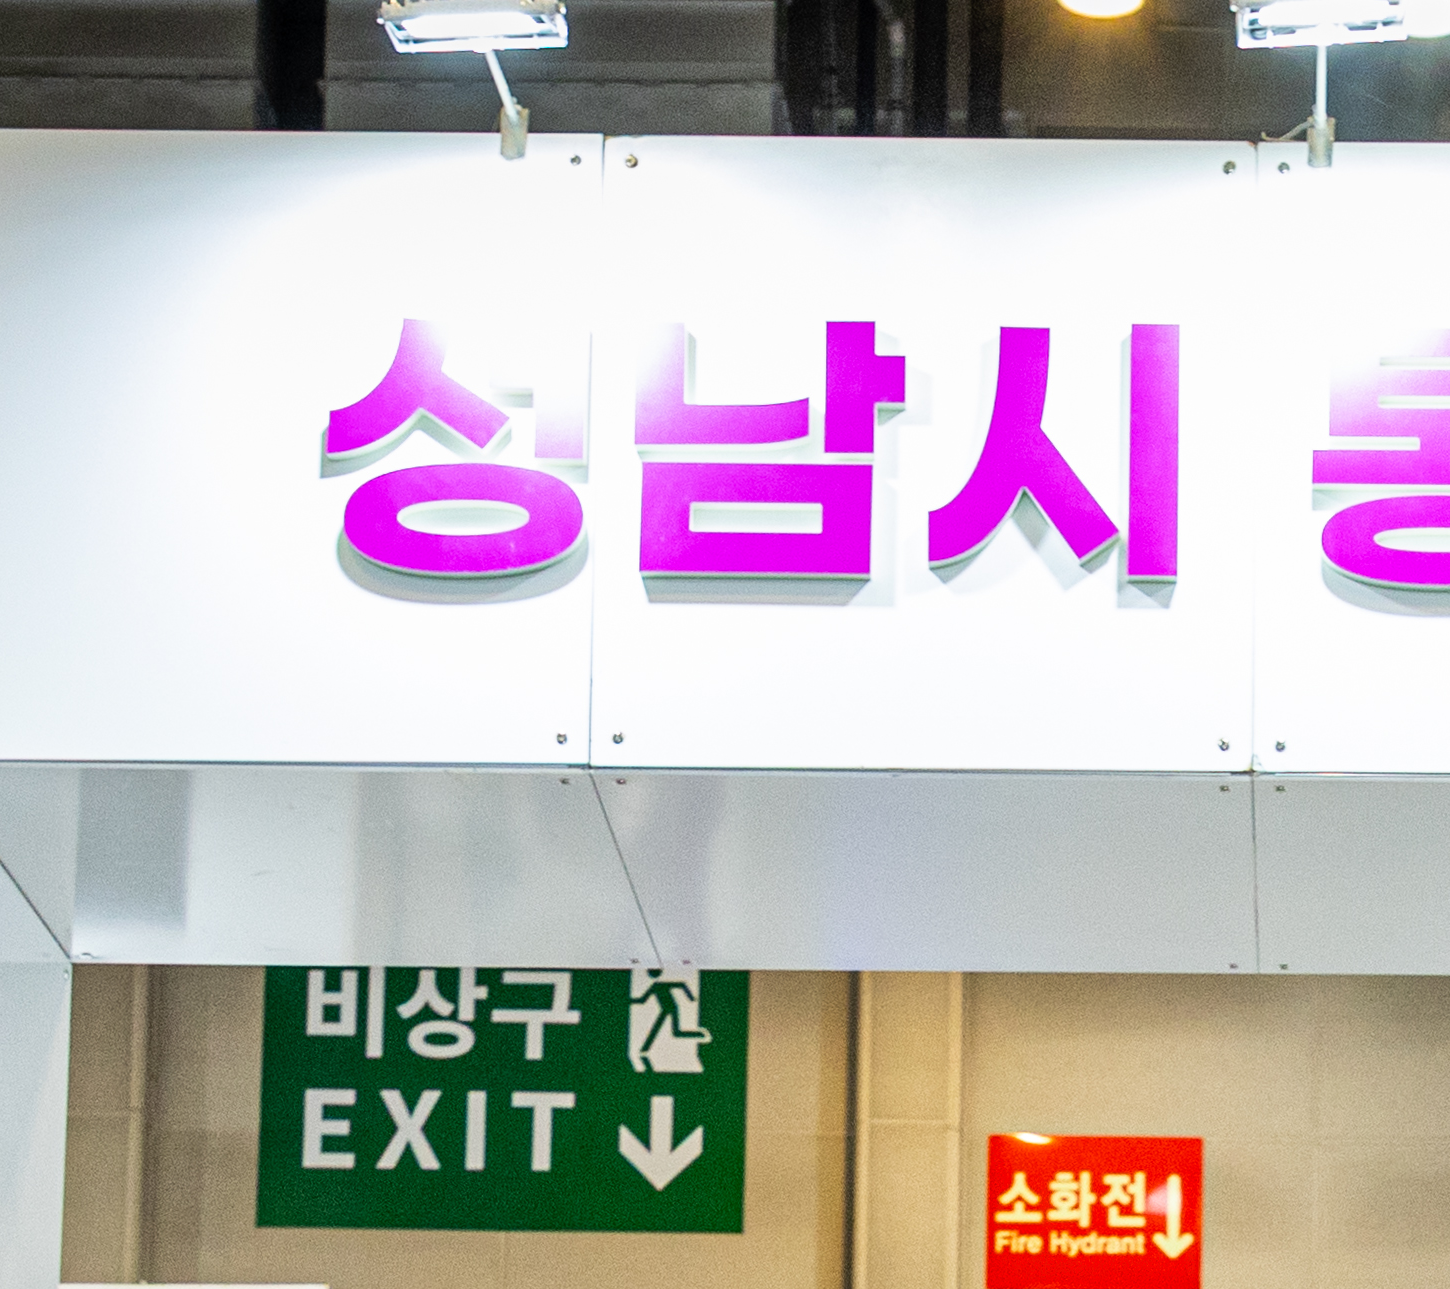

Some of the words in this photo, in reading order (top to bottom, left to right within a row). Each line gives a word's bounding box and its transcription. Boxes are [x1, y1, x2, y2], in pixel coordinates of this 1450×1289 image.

[323, 317, 1182, 588] 성남시
[305, 966, 582, 1061] 비상구
[301, 1087, 577, 1173] EXIT
[994, 1170, 1147, 1229] 소화전
[994, 1230, 1044, 1254] Fire
[1049, 1229, 1146, 1259] Hydrant
